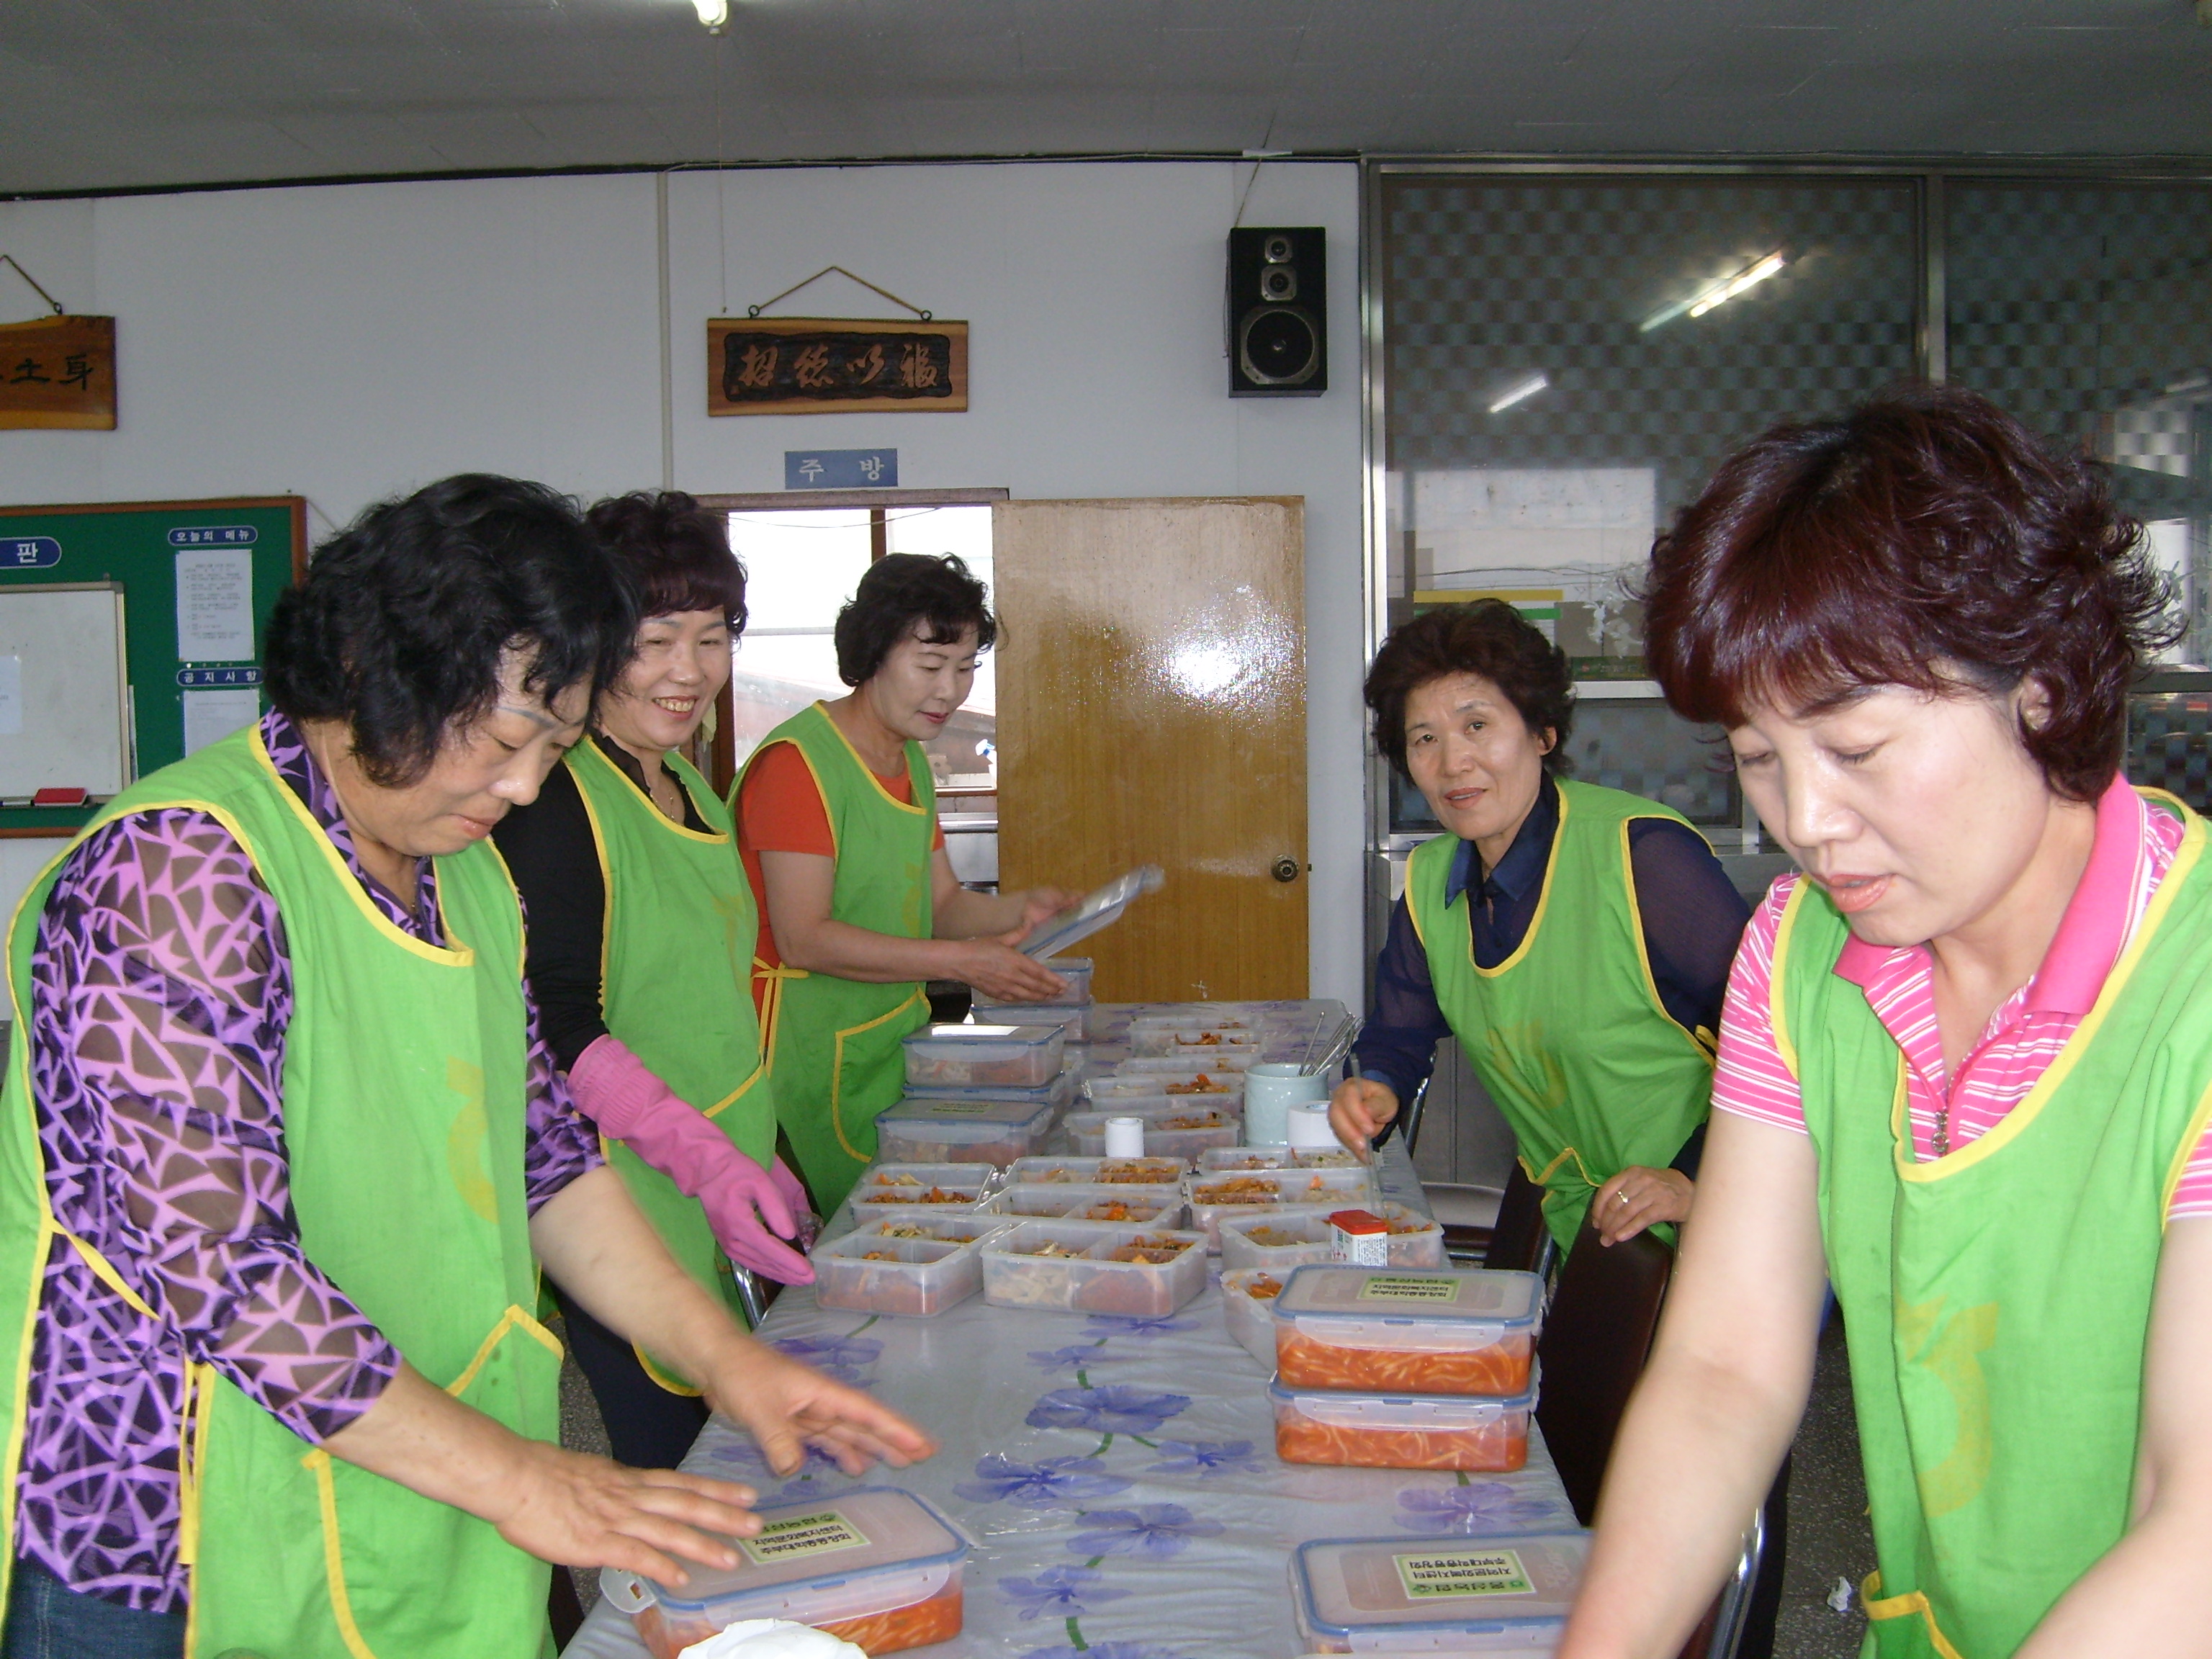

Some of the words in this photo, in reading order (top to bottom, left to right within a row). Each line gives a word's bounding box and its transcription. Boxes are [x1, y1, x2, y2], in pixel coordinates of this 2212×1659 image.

[176, 531, 214, 542] 오늘의
[225, 529, 250, 541] 메뉴
[17, 542, 39, 564] 판
